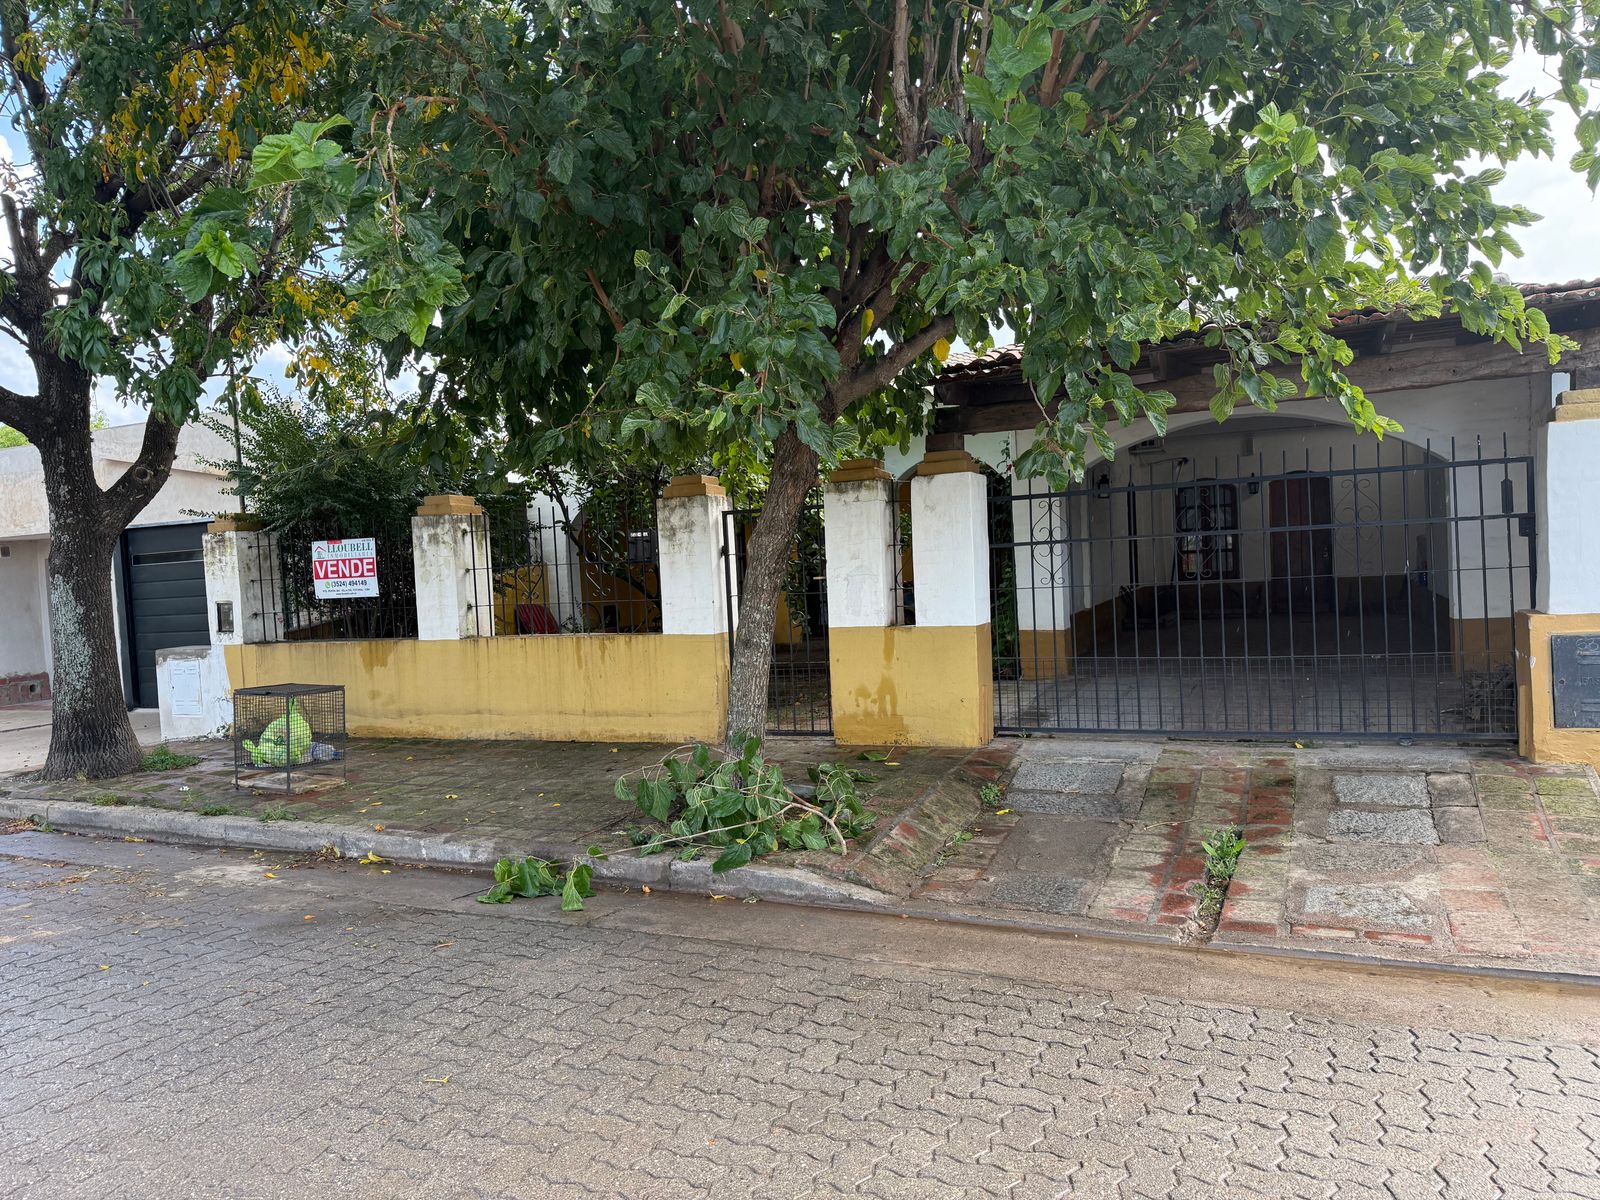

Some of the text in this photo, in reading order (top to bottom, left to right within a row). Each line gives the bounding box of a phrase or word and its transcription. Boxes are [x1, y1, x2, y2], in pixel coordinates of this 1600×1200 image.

[327, 543, 373, 553] LLOUBELL
[315, 559, 375, 578] VENDE
[331, 580, 347, 588] (3524)
